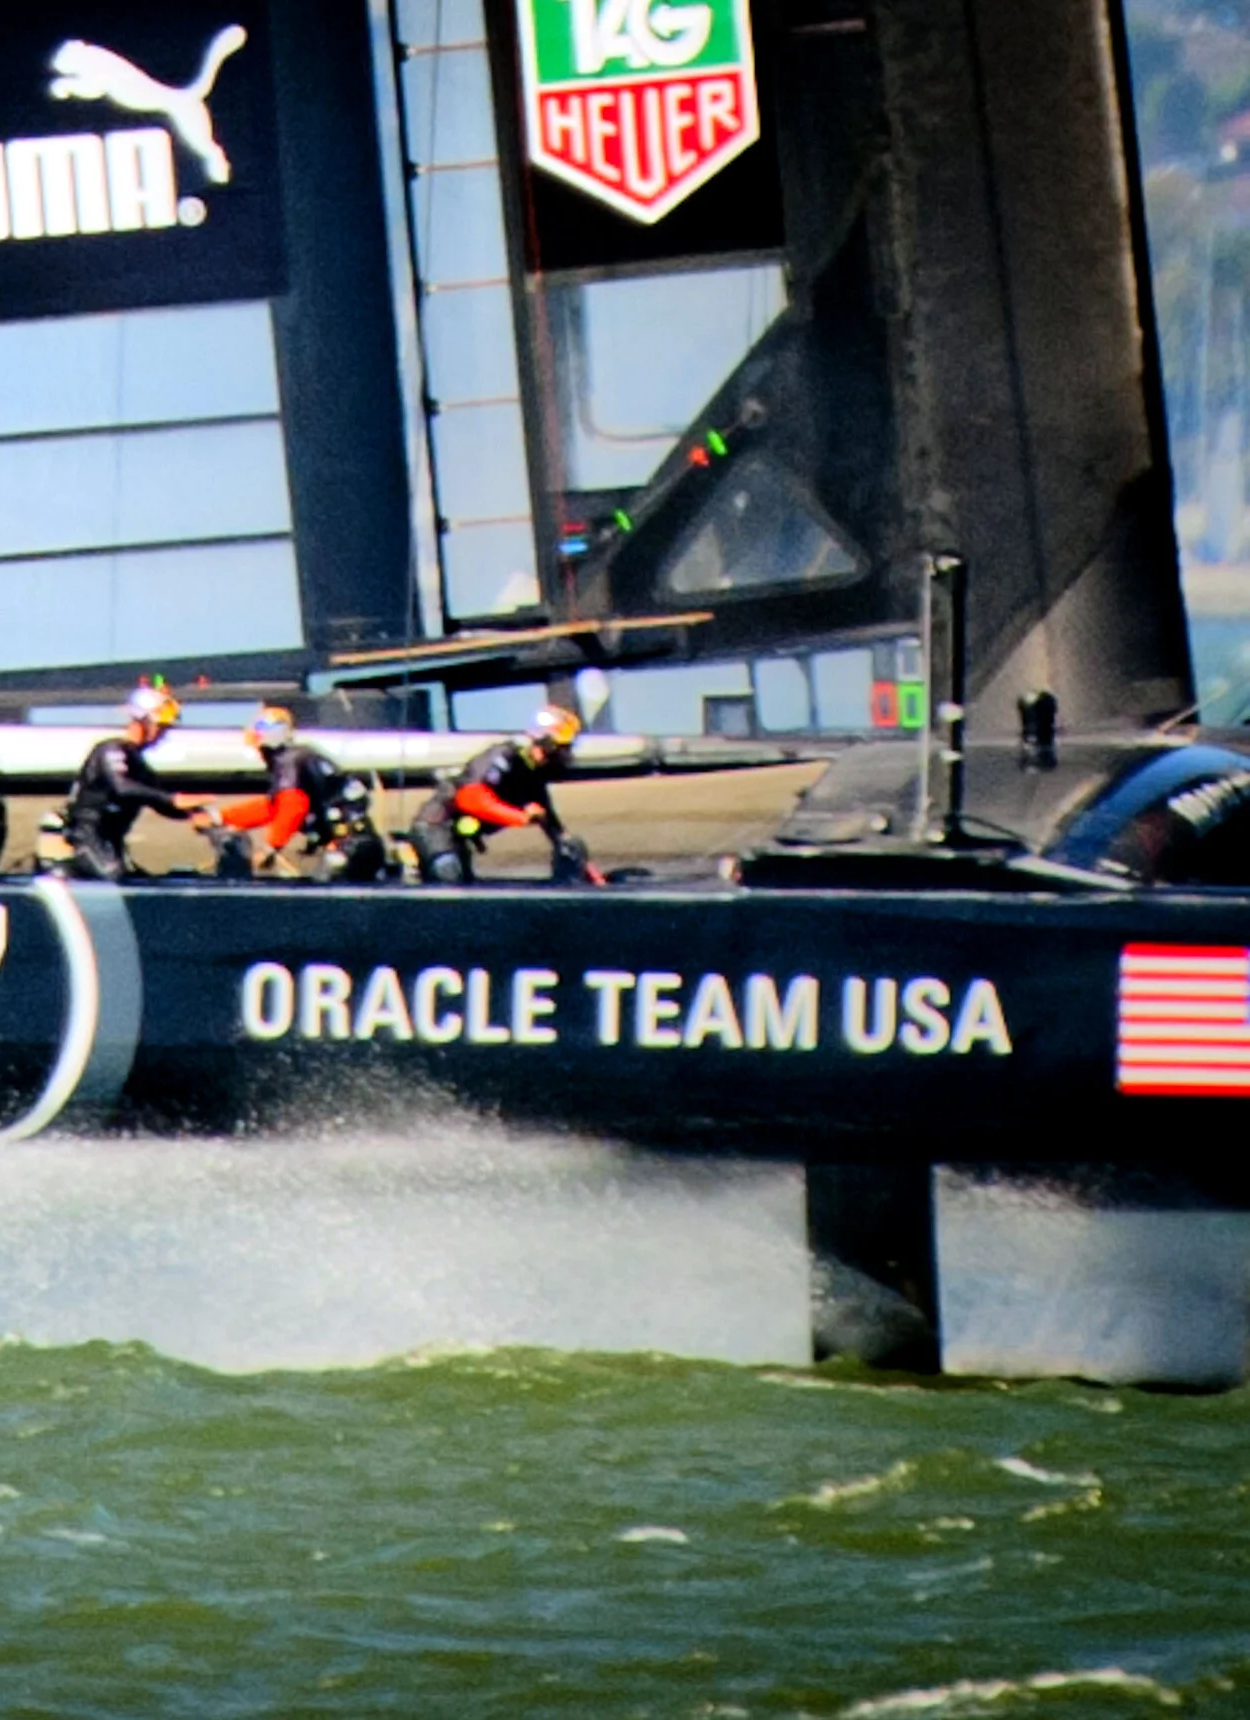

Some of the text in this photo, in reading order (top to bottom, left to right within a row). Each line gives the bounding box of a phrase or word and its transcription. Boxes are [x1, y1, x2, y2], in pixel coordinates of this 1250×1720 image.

[549, 78, 740, 199] HEUER
[241, 961, 1013, 1056] ORACLE TEAM USA
